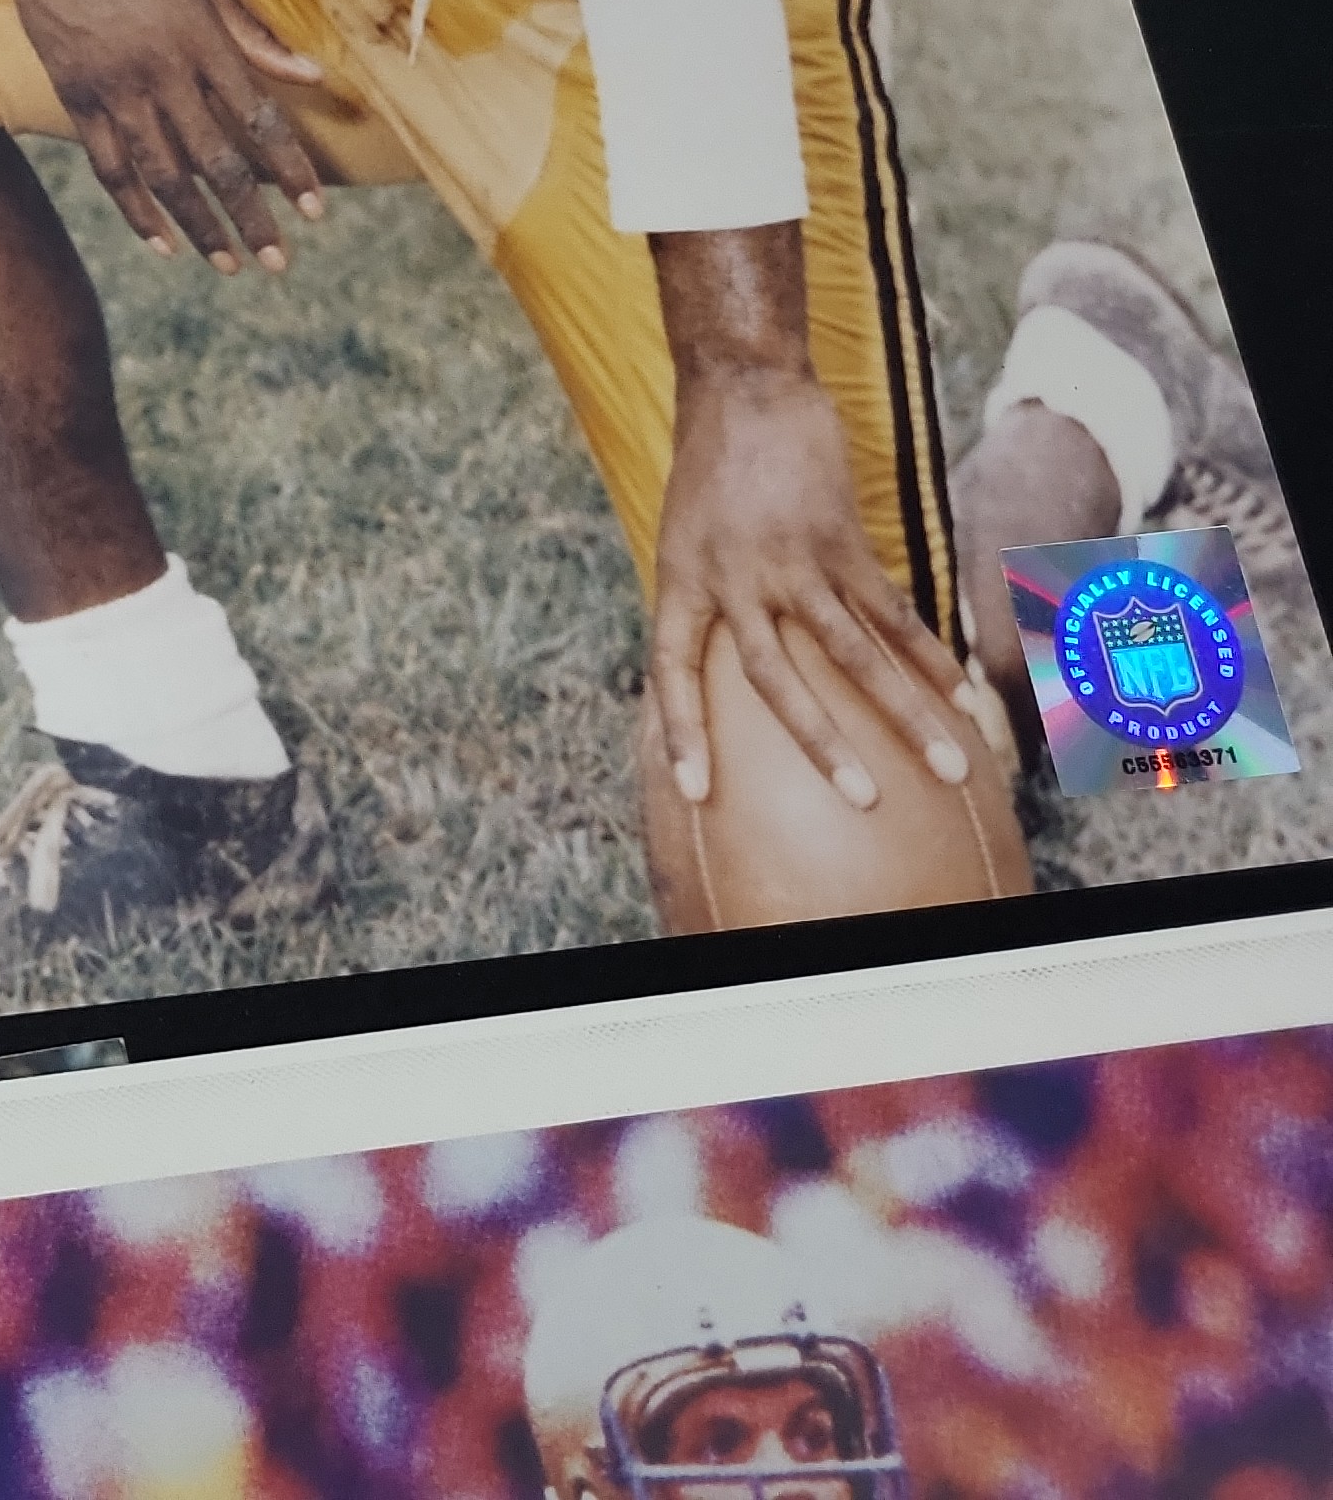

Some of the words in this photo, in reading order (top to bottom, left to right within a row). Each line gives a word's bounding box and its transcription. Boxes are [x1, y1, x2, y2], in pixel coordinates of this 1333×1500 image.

[1064, 570, 1132, 696] OFFICIALLY
[1145, 570, 1234, 679] LICENSED
[1112, 650, 1196, 699] NFL
[1108, 699, 1223, 741] PRODUCT
